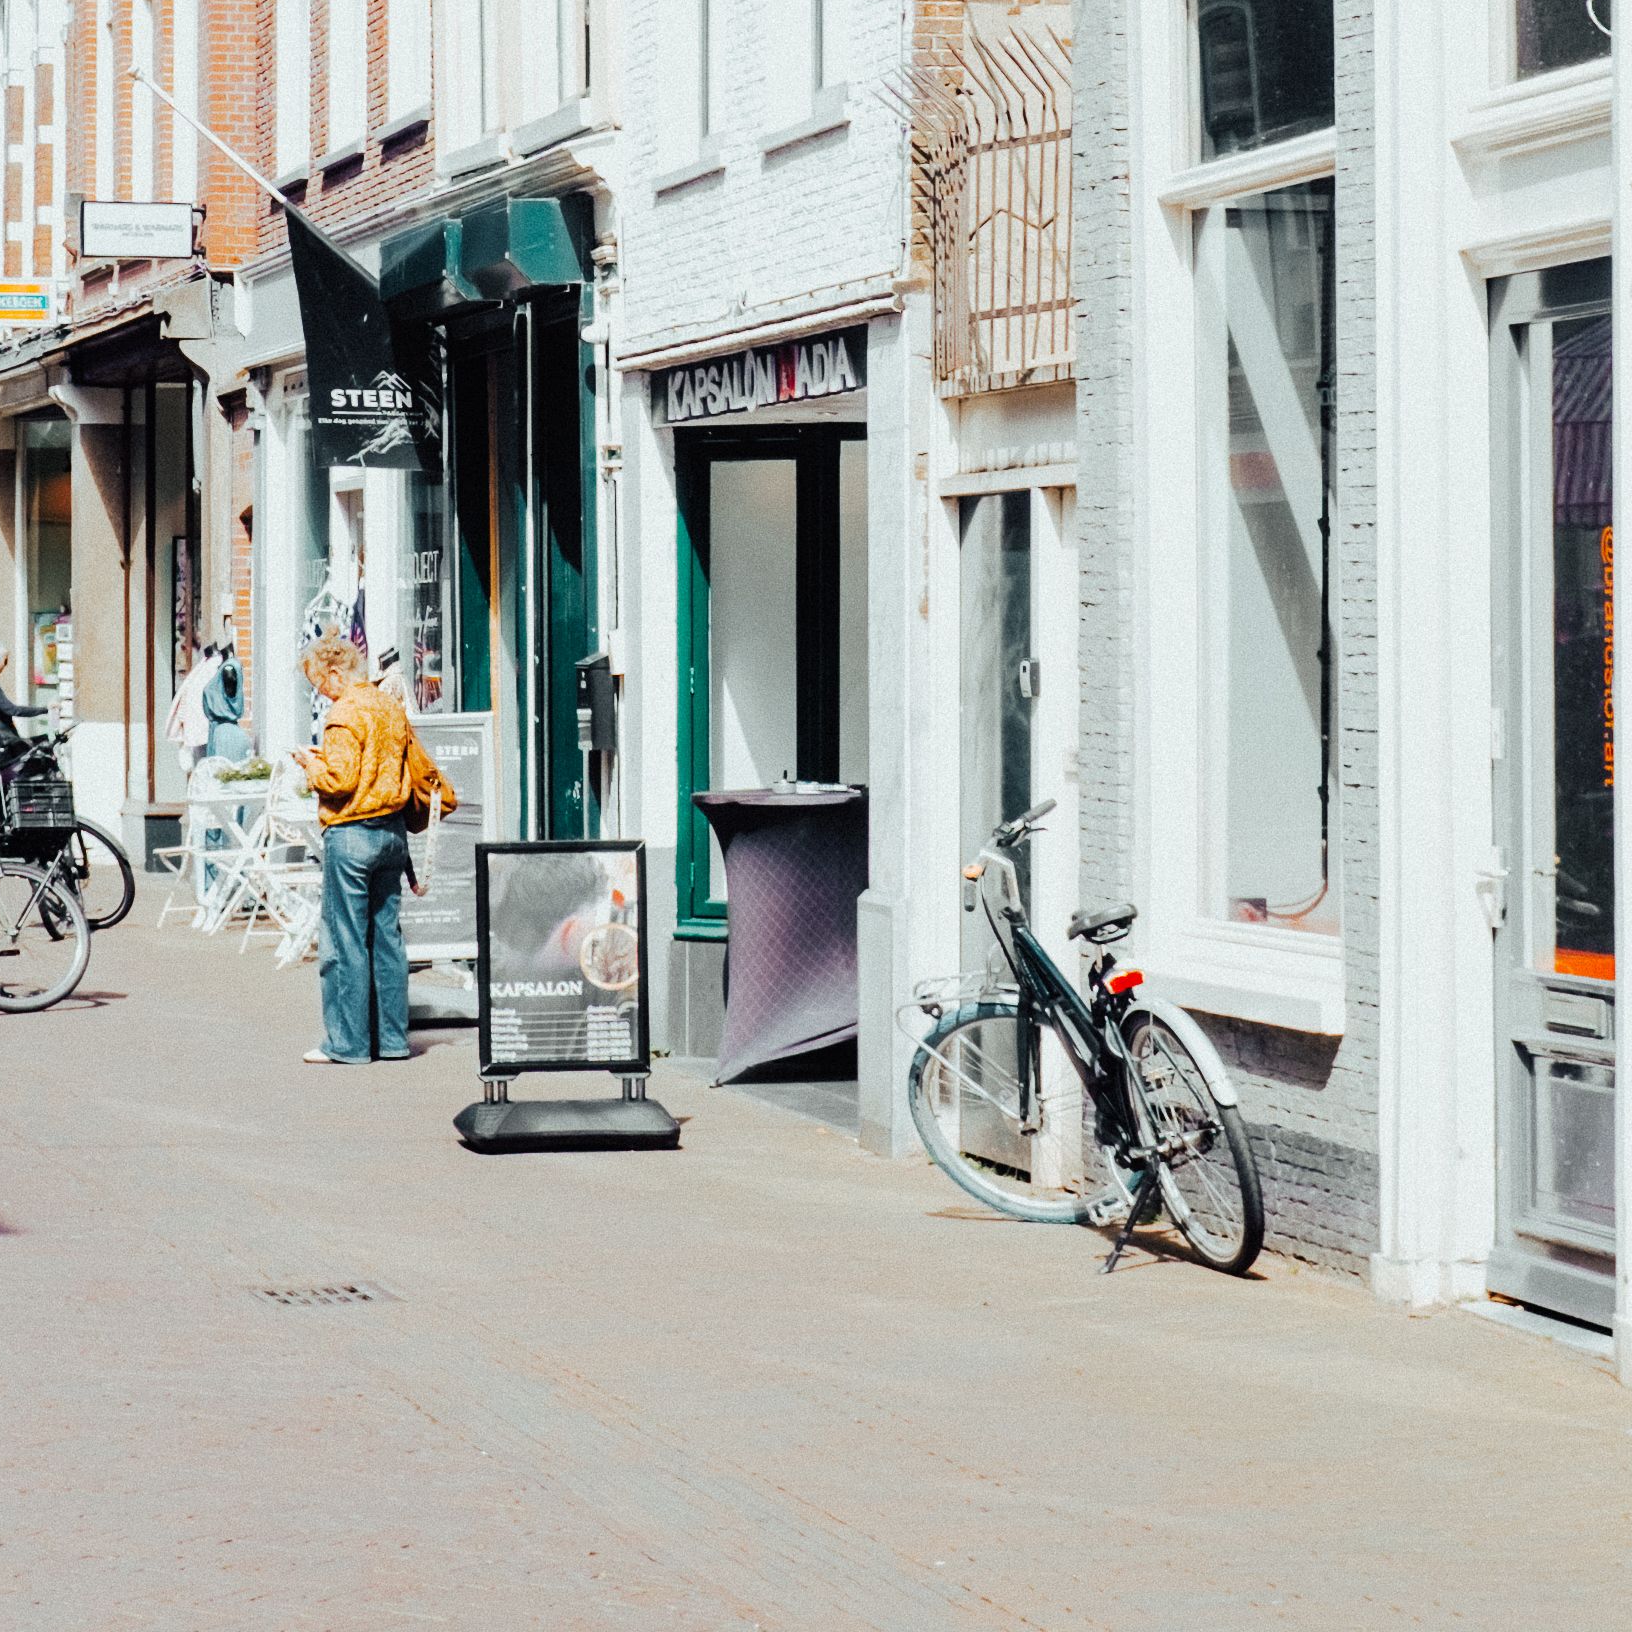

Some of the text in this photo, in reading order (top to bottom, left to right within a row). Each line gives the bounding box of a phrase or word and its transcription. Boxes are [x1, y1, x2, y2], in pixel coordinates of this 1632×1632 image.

[668, 347, 778, 422] KAPSALON
[330, 388, 413, 409] STEEN
[435, 745, 479, 757] STEEN
[490, 980, 584, 998] KAPSALON
